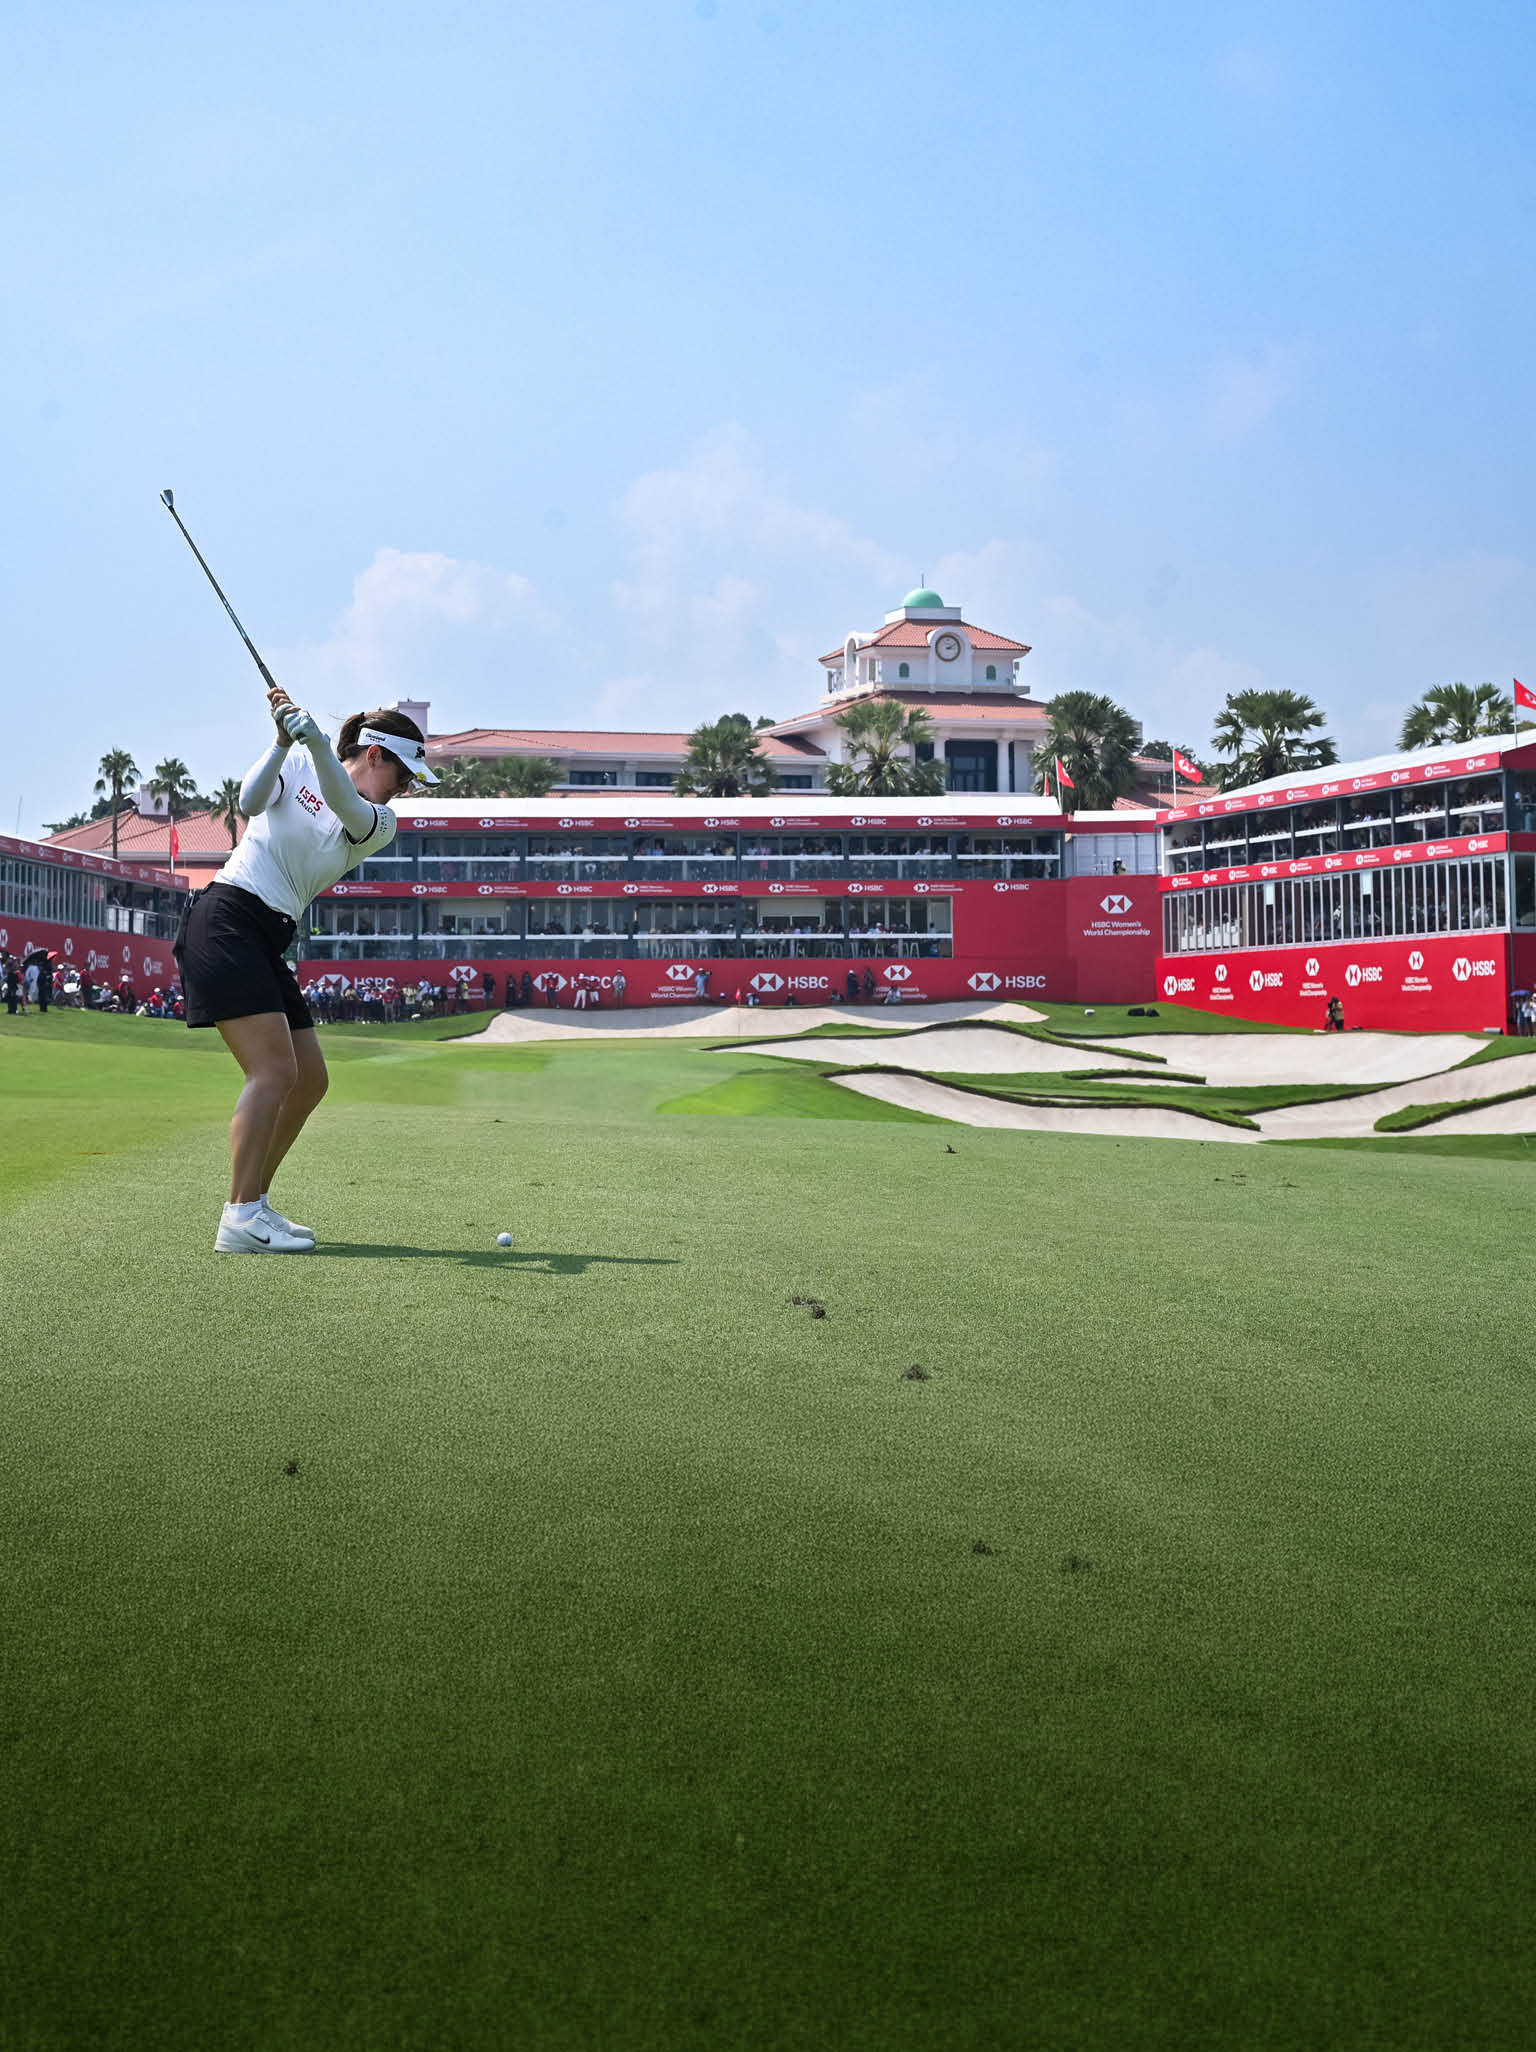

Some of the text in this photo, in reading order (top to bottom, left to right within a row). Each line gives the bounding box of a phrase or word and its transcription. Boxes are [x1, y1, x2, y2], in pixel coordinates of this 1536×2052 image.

[299, 785, 323, 811] ISPS
[295, 794, 316, 817] HANDA
[1104, 928, 1151, 937] Championship
[1362, 967, 1383, 982] HSBC
[1472, 960, 1496, 976] HSBC
[788, 976, 829, 989] HSBC
[1005, 976, 1046, 988] HSBC
[1178, 978, 1195, 992] HSBC
[1264, 973, 1283, 987] HSBC
